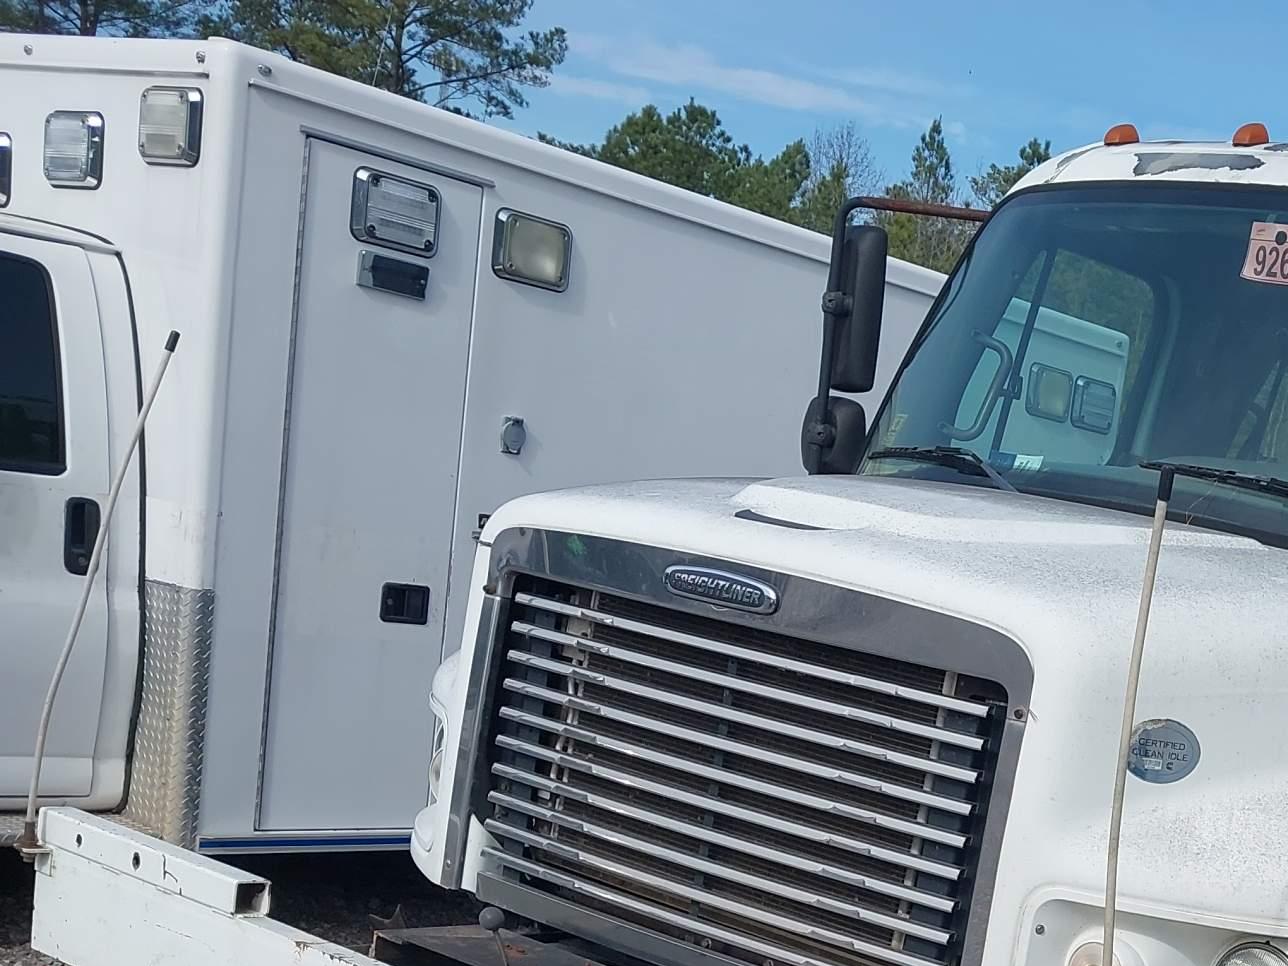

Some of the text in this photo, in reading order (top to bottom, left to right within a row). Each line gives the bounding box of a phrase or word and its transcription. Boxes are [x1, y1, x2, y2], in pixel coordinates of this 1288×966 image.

[674, 572, 761, 604] FREIGHTLINER
[1138, 738, 1186, 751] CERTIFIED
[1132, 747, 1188, 762] CLEAN IDLE
